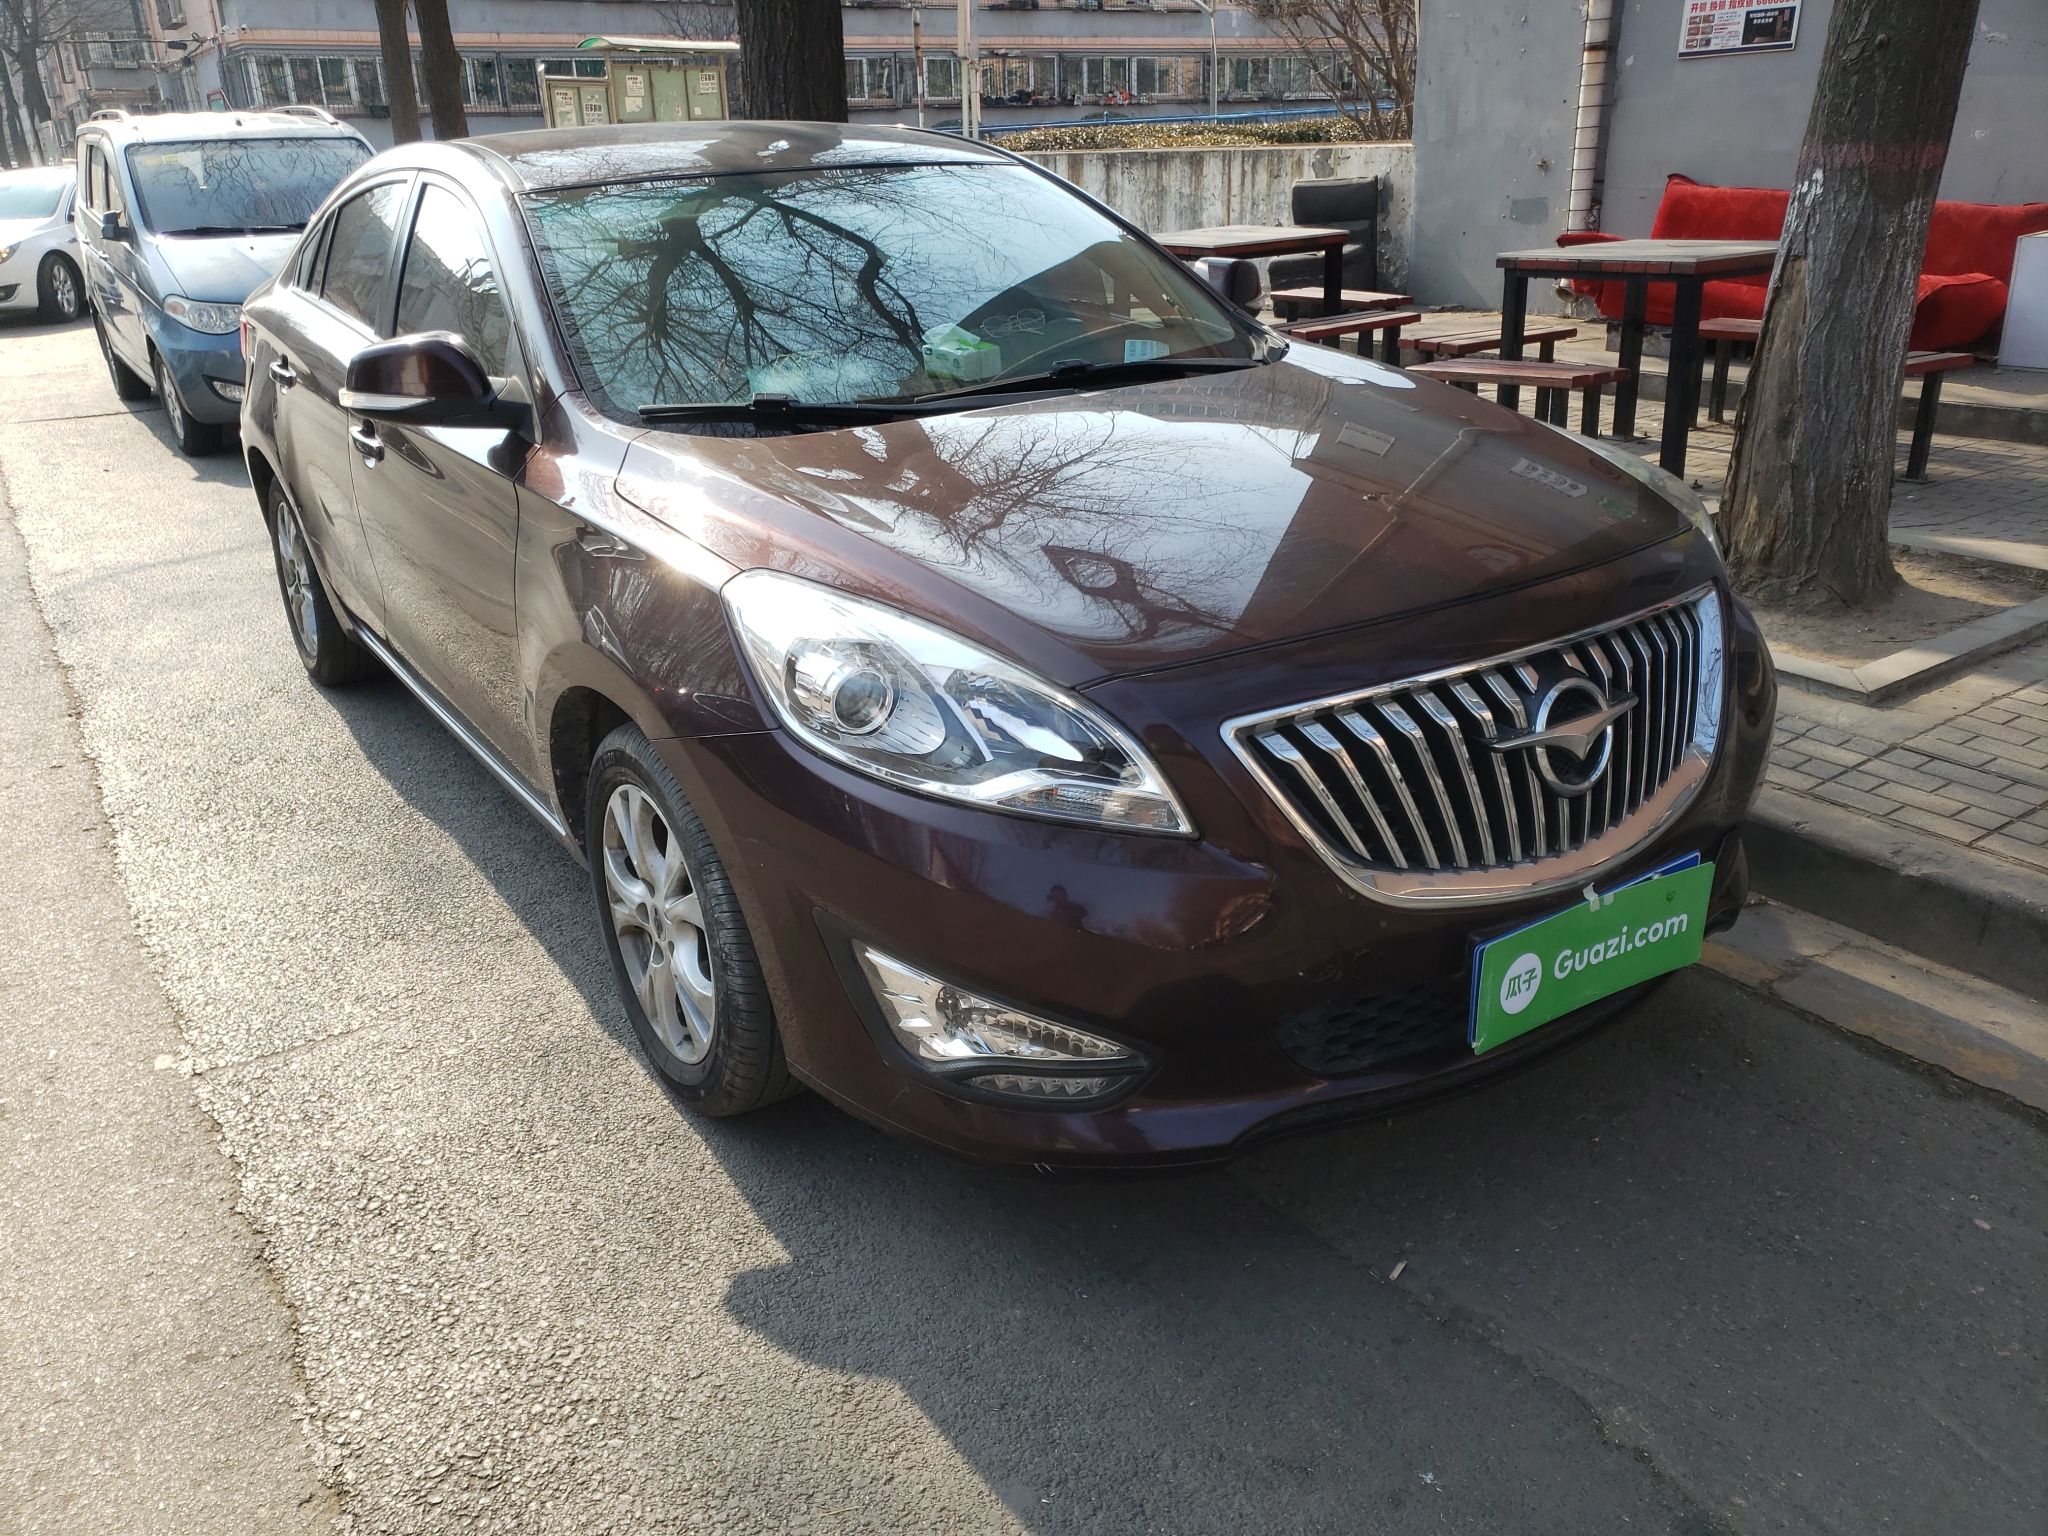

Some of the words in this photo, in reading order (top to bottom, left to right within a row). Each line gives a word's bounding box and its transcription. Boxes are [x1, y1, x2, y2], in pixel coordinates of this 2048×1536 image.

[1691, 2, 1707, 13] 开锁
[1553, 913, 1688, 980] Guazi.com
[1505, 967, 1538, 1001] 瓜子
